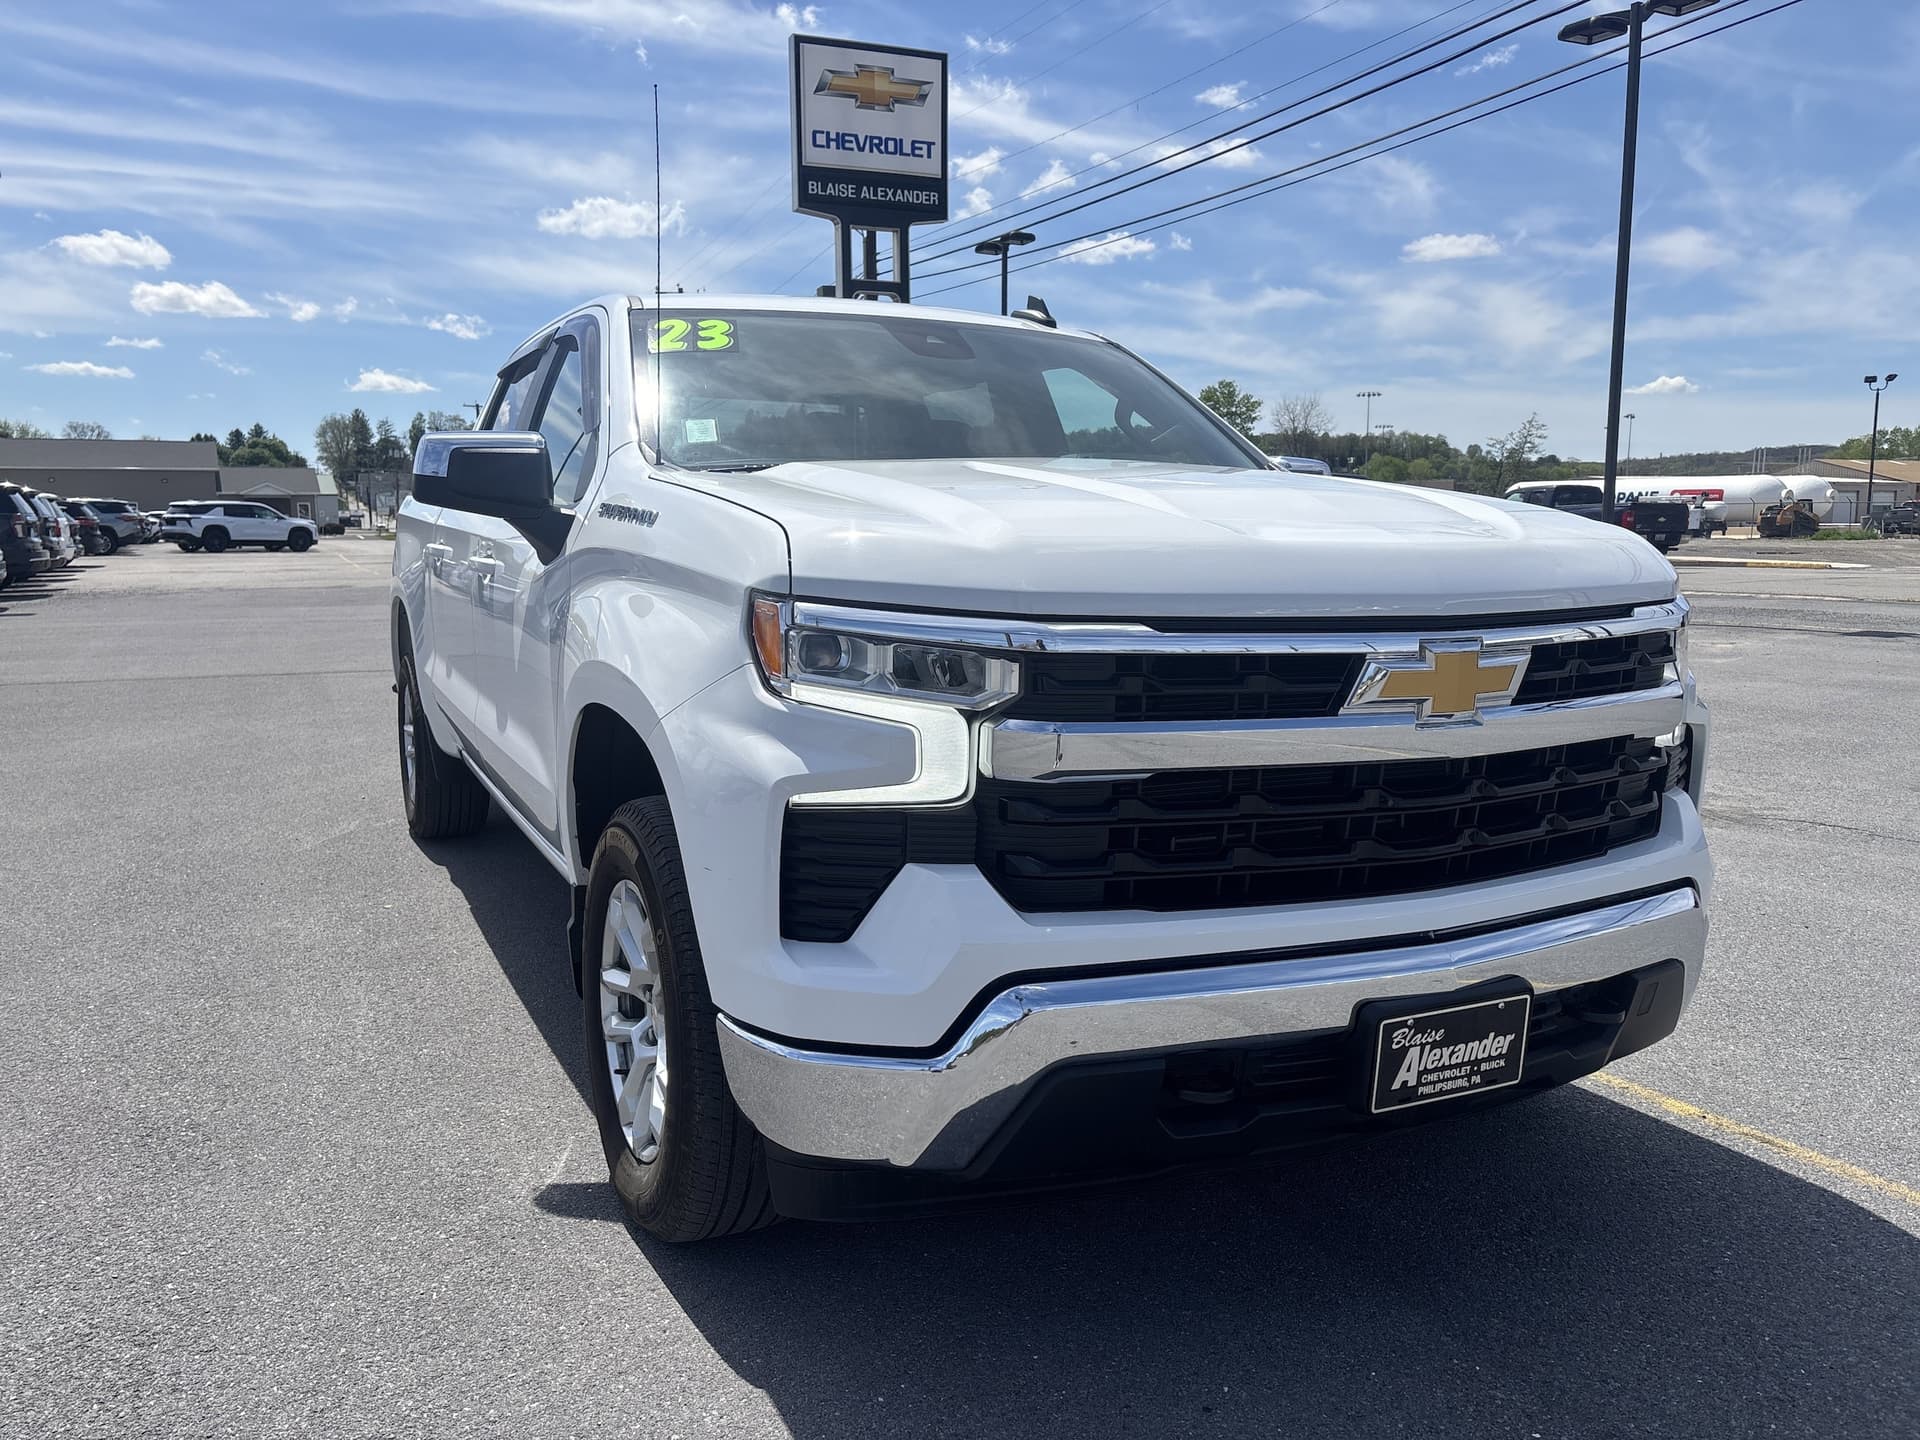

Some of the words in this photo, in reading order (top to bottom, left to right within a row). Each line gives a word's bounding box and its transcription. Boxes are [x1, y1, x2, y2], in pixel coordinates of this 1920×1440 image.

[812, 129, 936, 160] CHEVROLET
[808, 181, 857, 198] BLAISE
[860, 185, 939, 205] ALEXANDER
[653, 318, 734, 351] 23
[1391, 1027, 1446, 1050] Blaise
[1390, 1031, 1516, 1090] Alexander
[1421, 1066, 1471, 1084] CHEVROLET
[1480, 1058, 1506, 1071] BUICK
[1418, 1077, 1470, 1096] PHILIPSBURG,
[1470, 1074, 1481, 1084] PA
